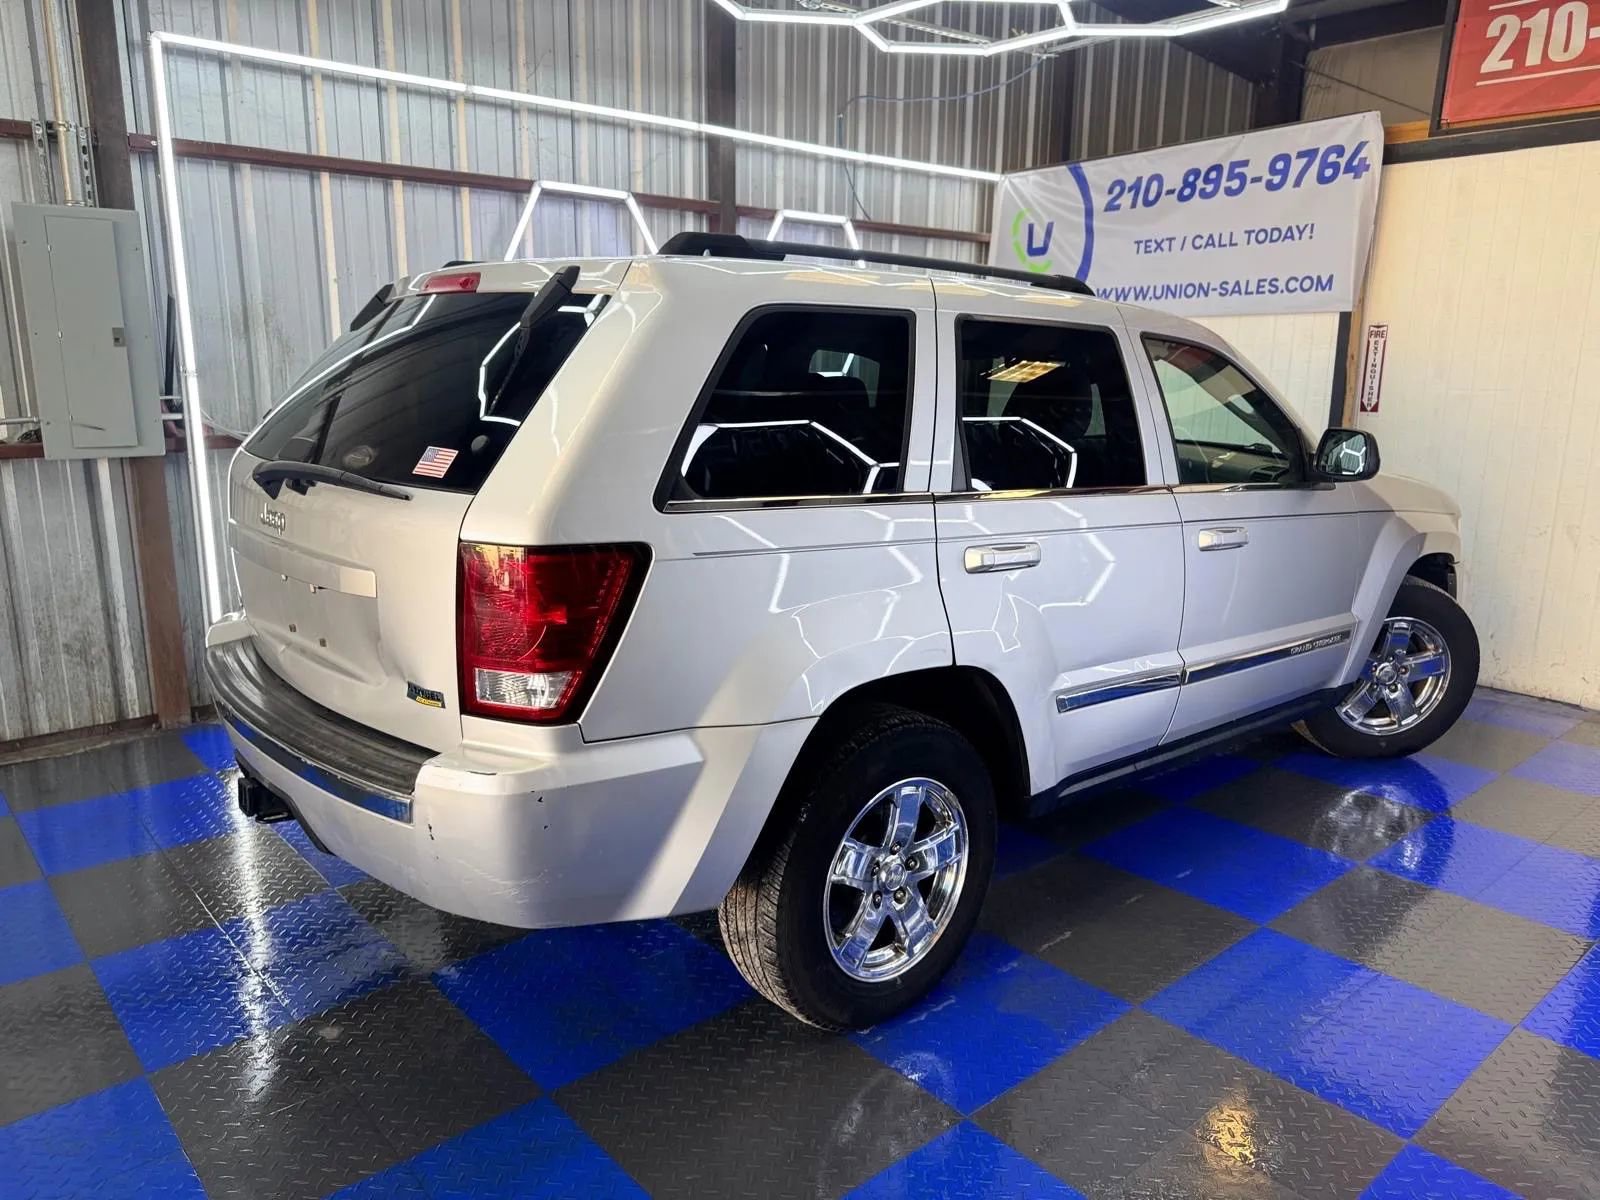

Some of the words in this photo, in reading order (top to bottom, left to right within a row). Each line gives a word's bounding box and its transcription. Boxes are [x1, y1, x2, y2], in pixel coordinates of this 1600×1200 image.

[1103, 141, 1371, 212] 210-895-9764
[1134, 237, 1176, 255] TEXT
[1180, 236, 1188, 251] /
[1191, 231, 1239, 250] CALL
[1243, 223, 1316, 246] TODAY!
[1096, 274, 1335, 302] WWW.UNION-SALES.COM
[1369, 330, 1386, 339] FIRE
[260, 502, 286, 536] Jeep
